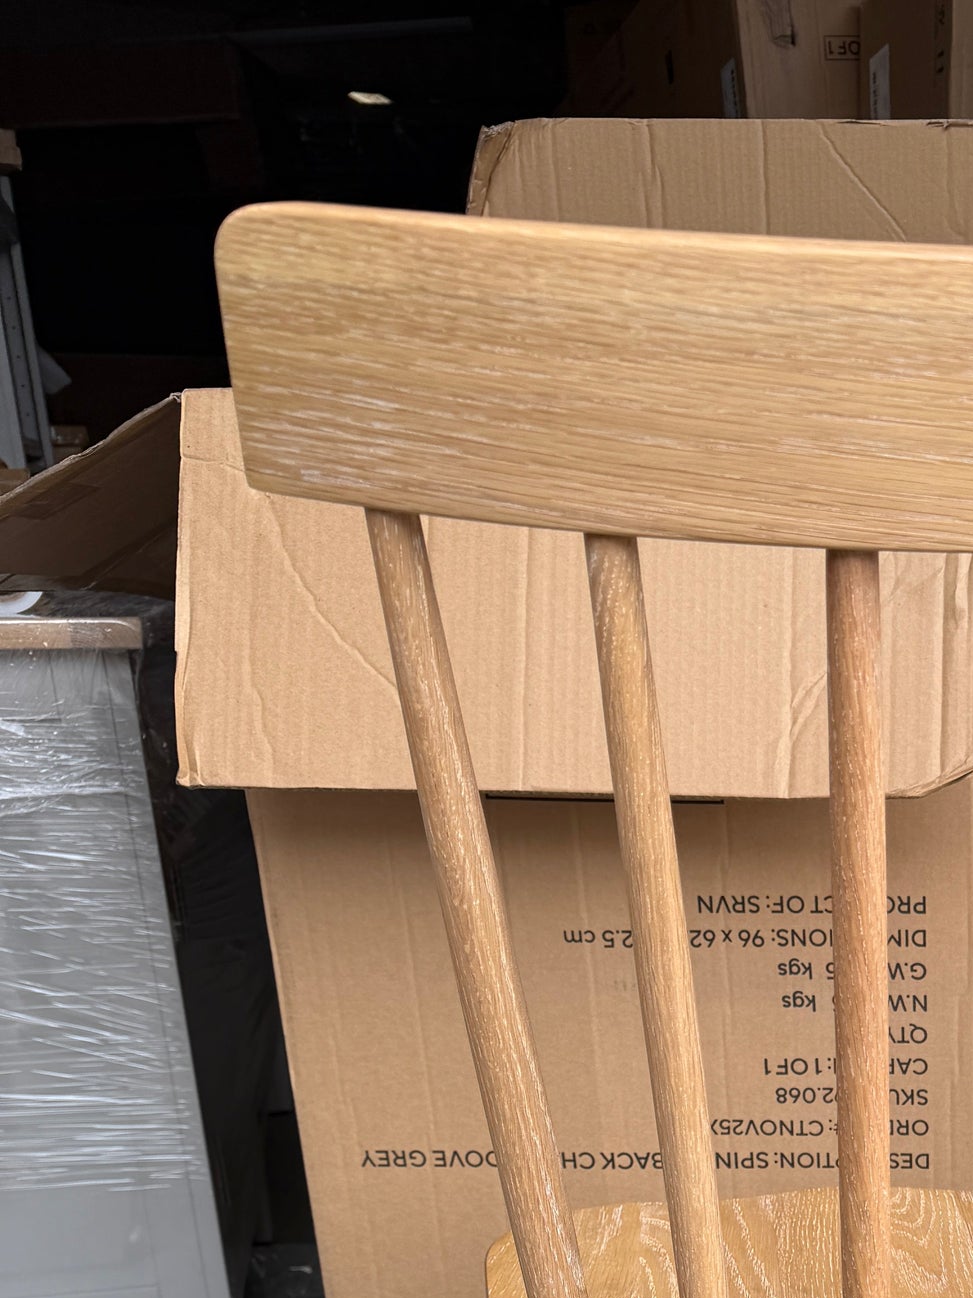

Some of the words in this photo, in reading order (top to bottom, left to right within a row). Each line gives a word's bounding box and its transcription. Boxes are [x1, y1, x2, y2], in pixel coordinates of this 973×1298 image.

[697, 896, 760, 914] SRVN
[766, 896, 805, 914] OF:
[563, 930, 596, 943] cm
[721, 930, 733, 943] x
[738, 930, 765, 948] 96
[771, 929, 927, 948] DIMIONS:
[777, 959, 813, 980] kgs
[781, 991, 816, 1012] kgs
[764, 1058, 771, 1075] 1
[775, 1058, 809, 1075] OF
[815, 1058, 823, 1075] 1
[362, 1150, 427, 1168] GREY
